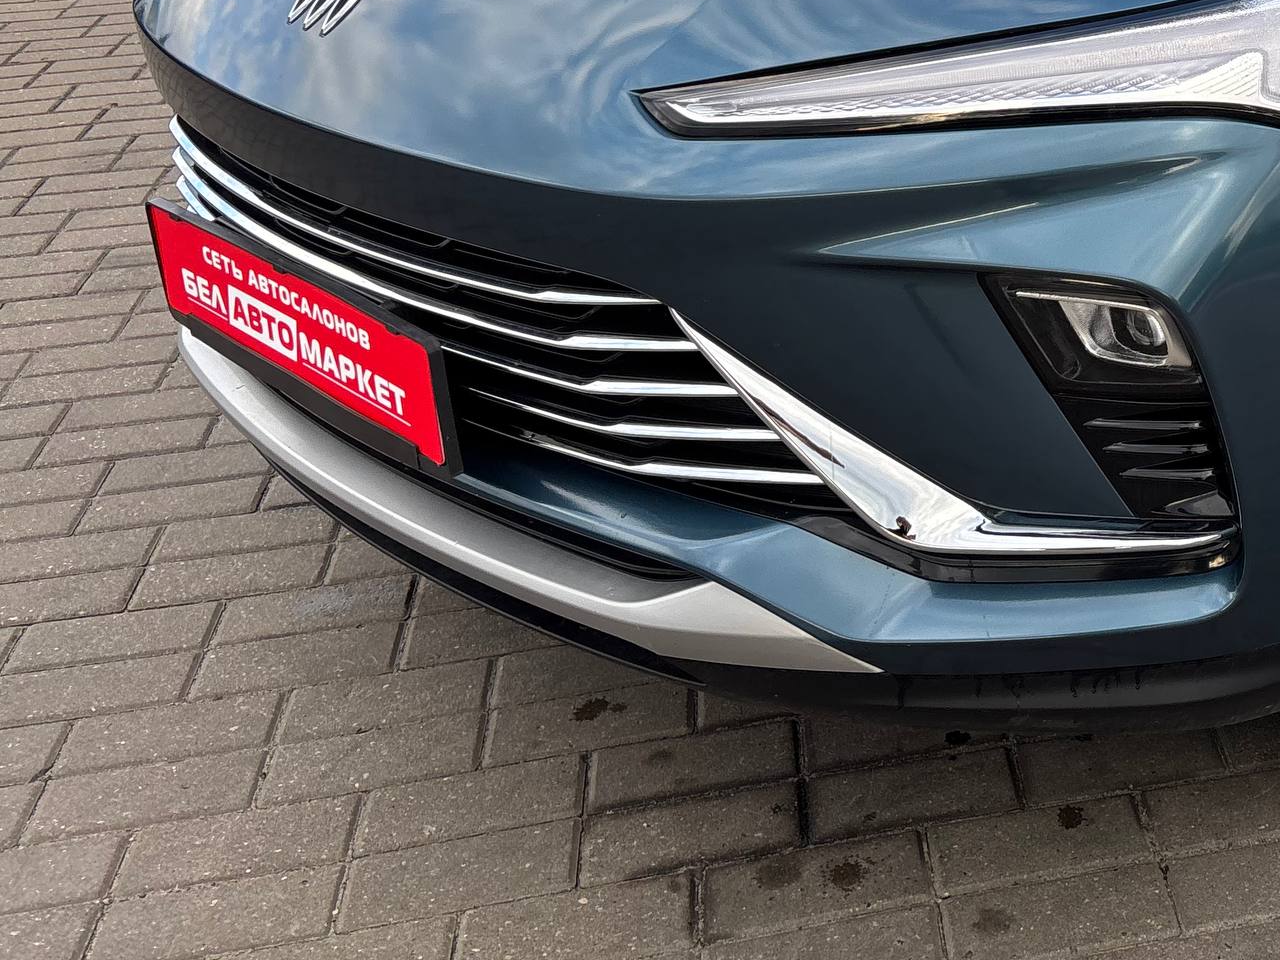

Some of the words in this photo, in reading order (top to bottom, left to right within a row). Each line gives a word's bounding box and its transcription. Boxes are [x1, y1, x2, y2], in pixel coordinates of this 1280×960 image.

[181, 268, 228, 315] БЕЛ
[231, 294, 295, 356] АВТО
[299, 331, 406, 416] МАРКЕТ
[202, 245, 243, 280] СЕТЬ
[248, 269, 371, 351] АВТОСАЛОНОВ
